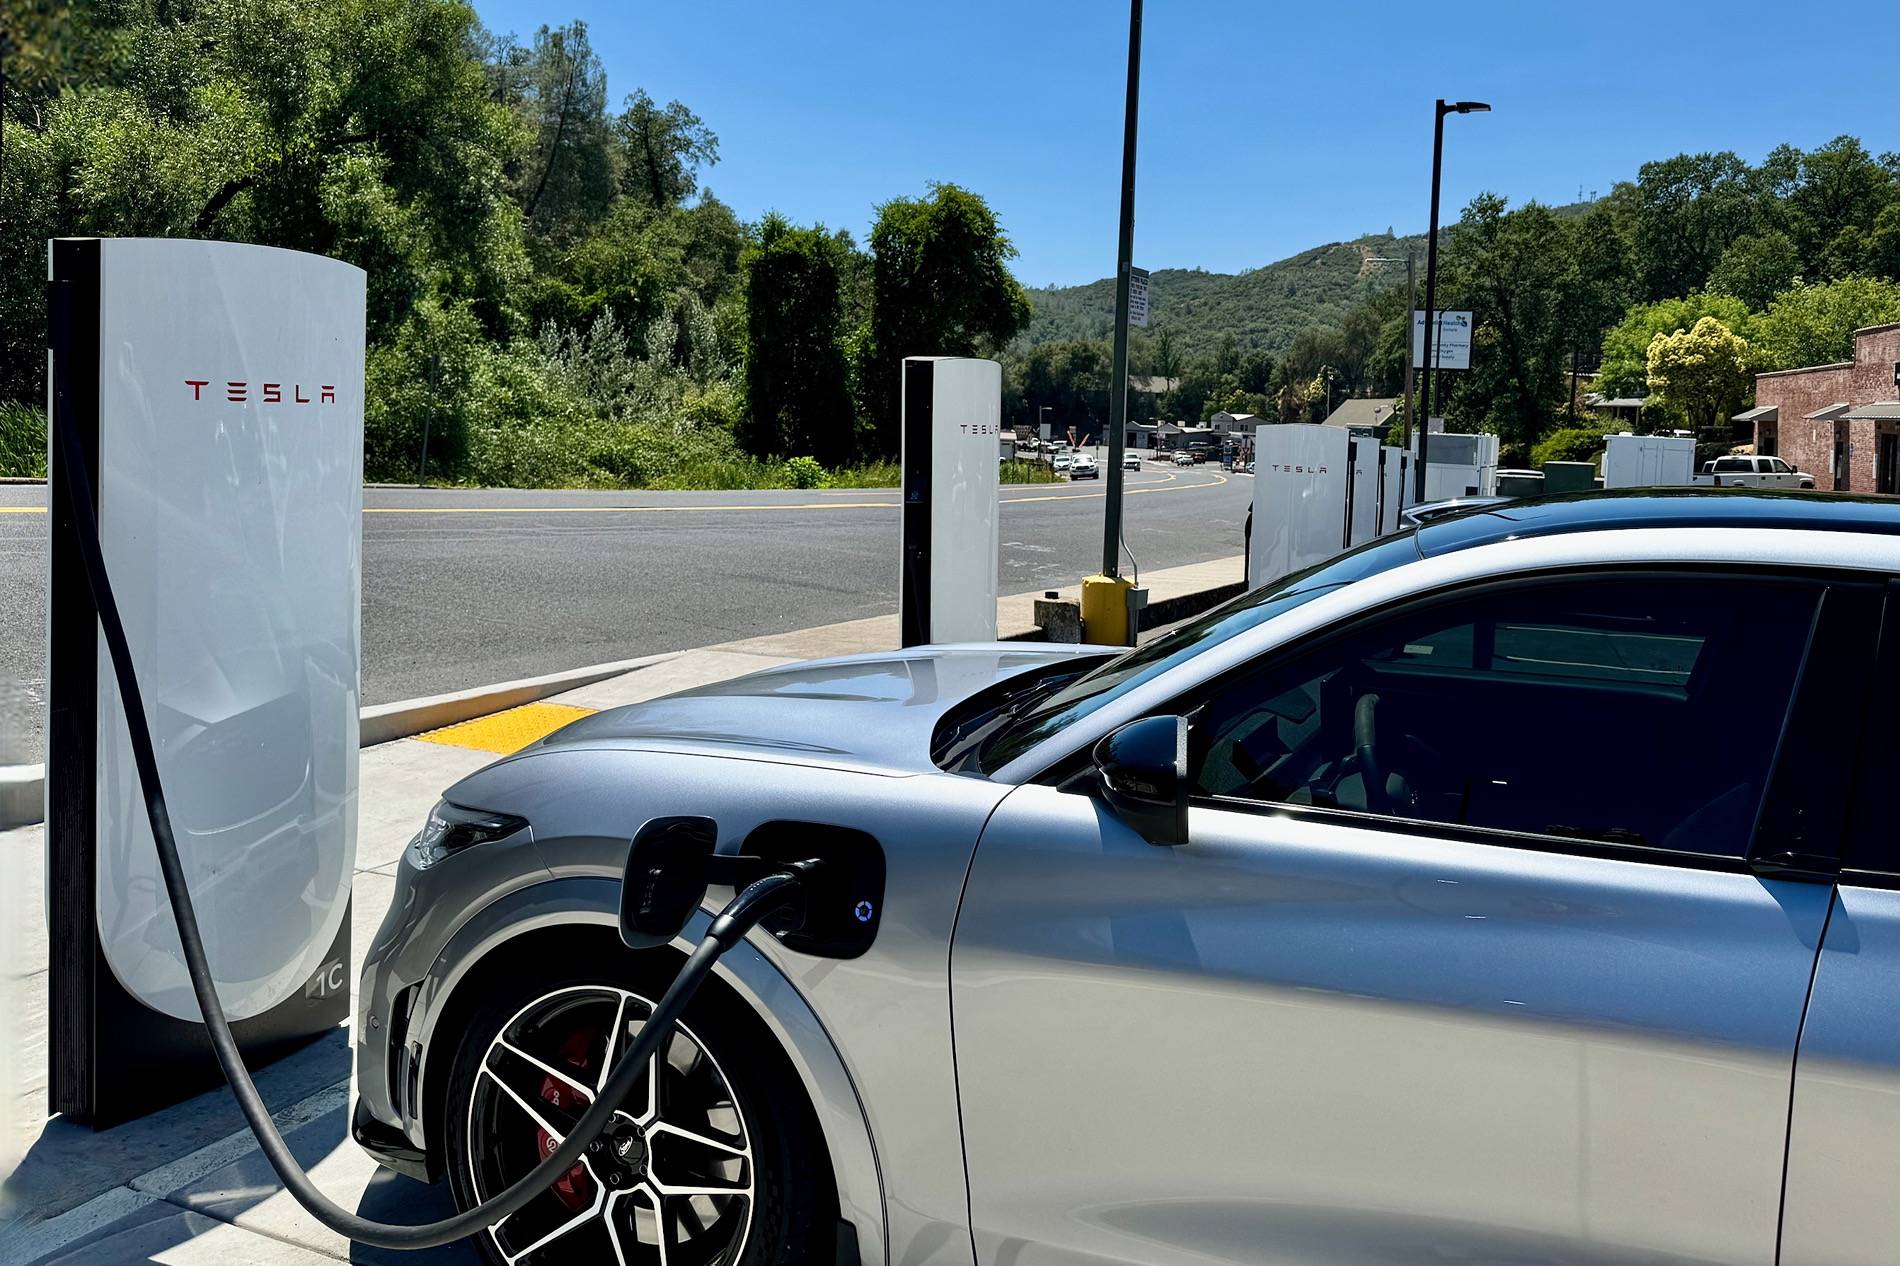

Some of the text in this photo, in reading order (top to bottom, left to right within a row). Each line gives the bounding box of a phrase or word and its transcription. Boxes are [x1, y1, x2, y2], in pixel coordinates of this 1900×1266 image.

[184, 380, 335, 404] TESLA
[960, 424, 998, 435] TESLA
[1272, 464, 1328, 474] TESLA
[315, 963, 343, 996] 1C
